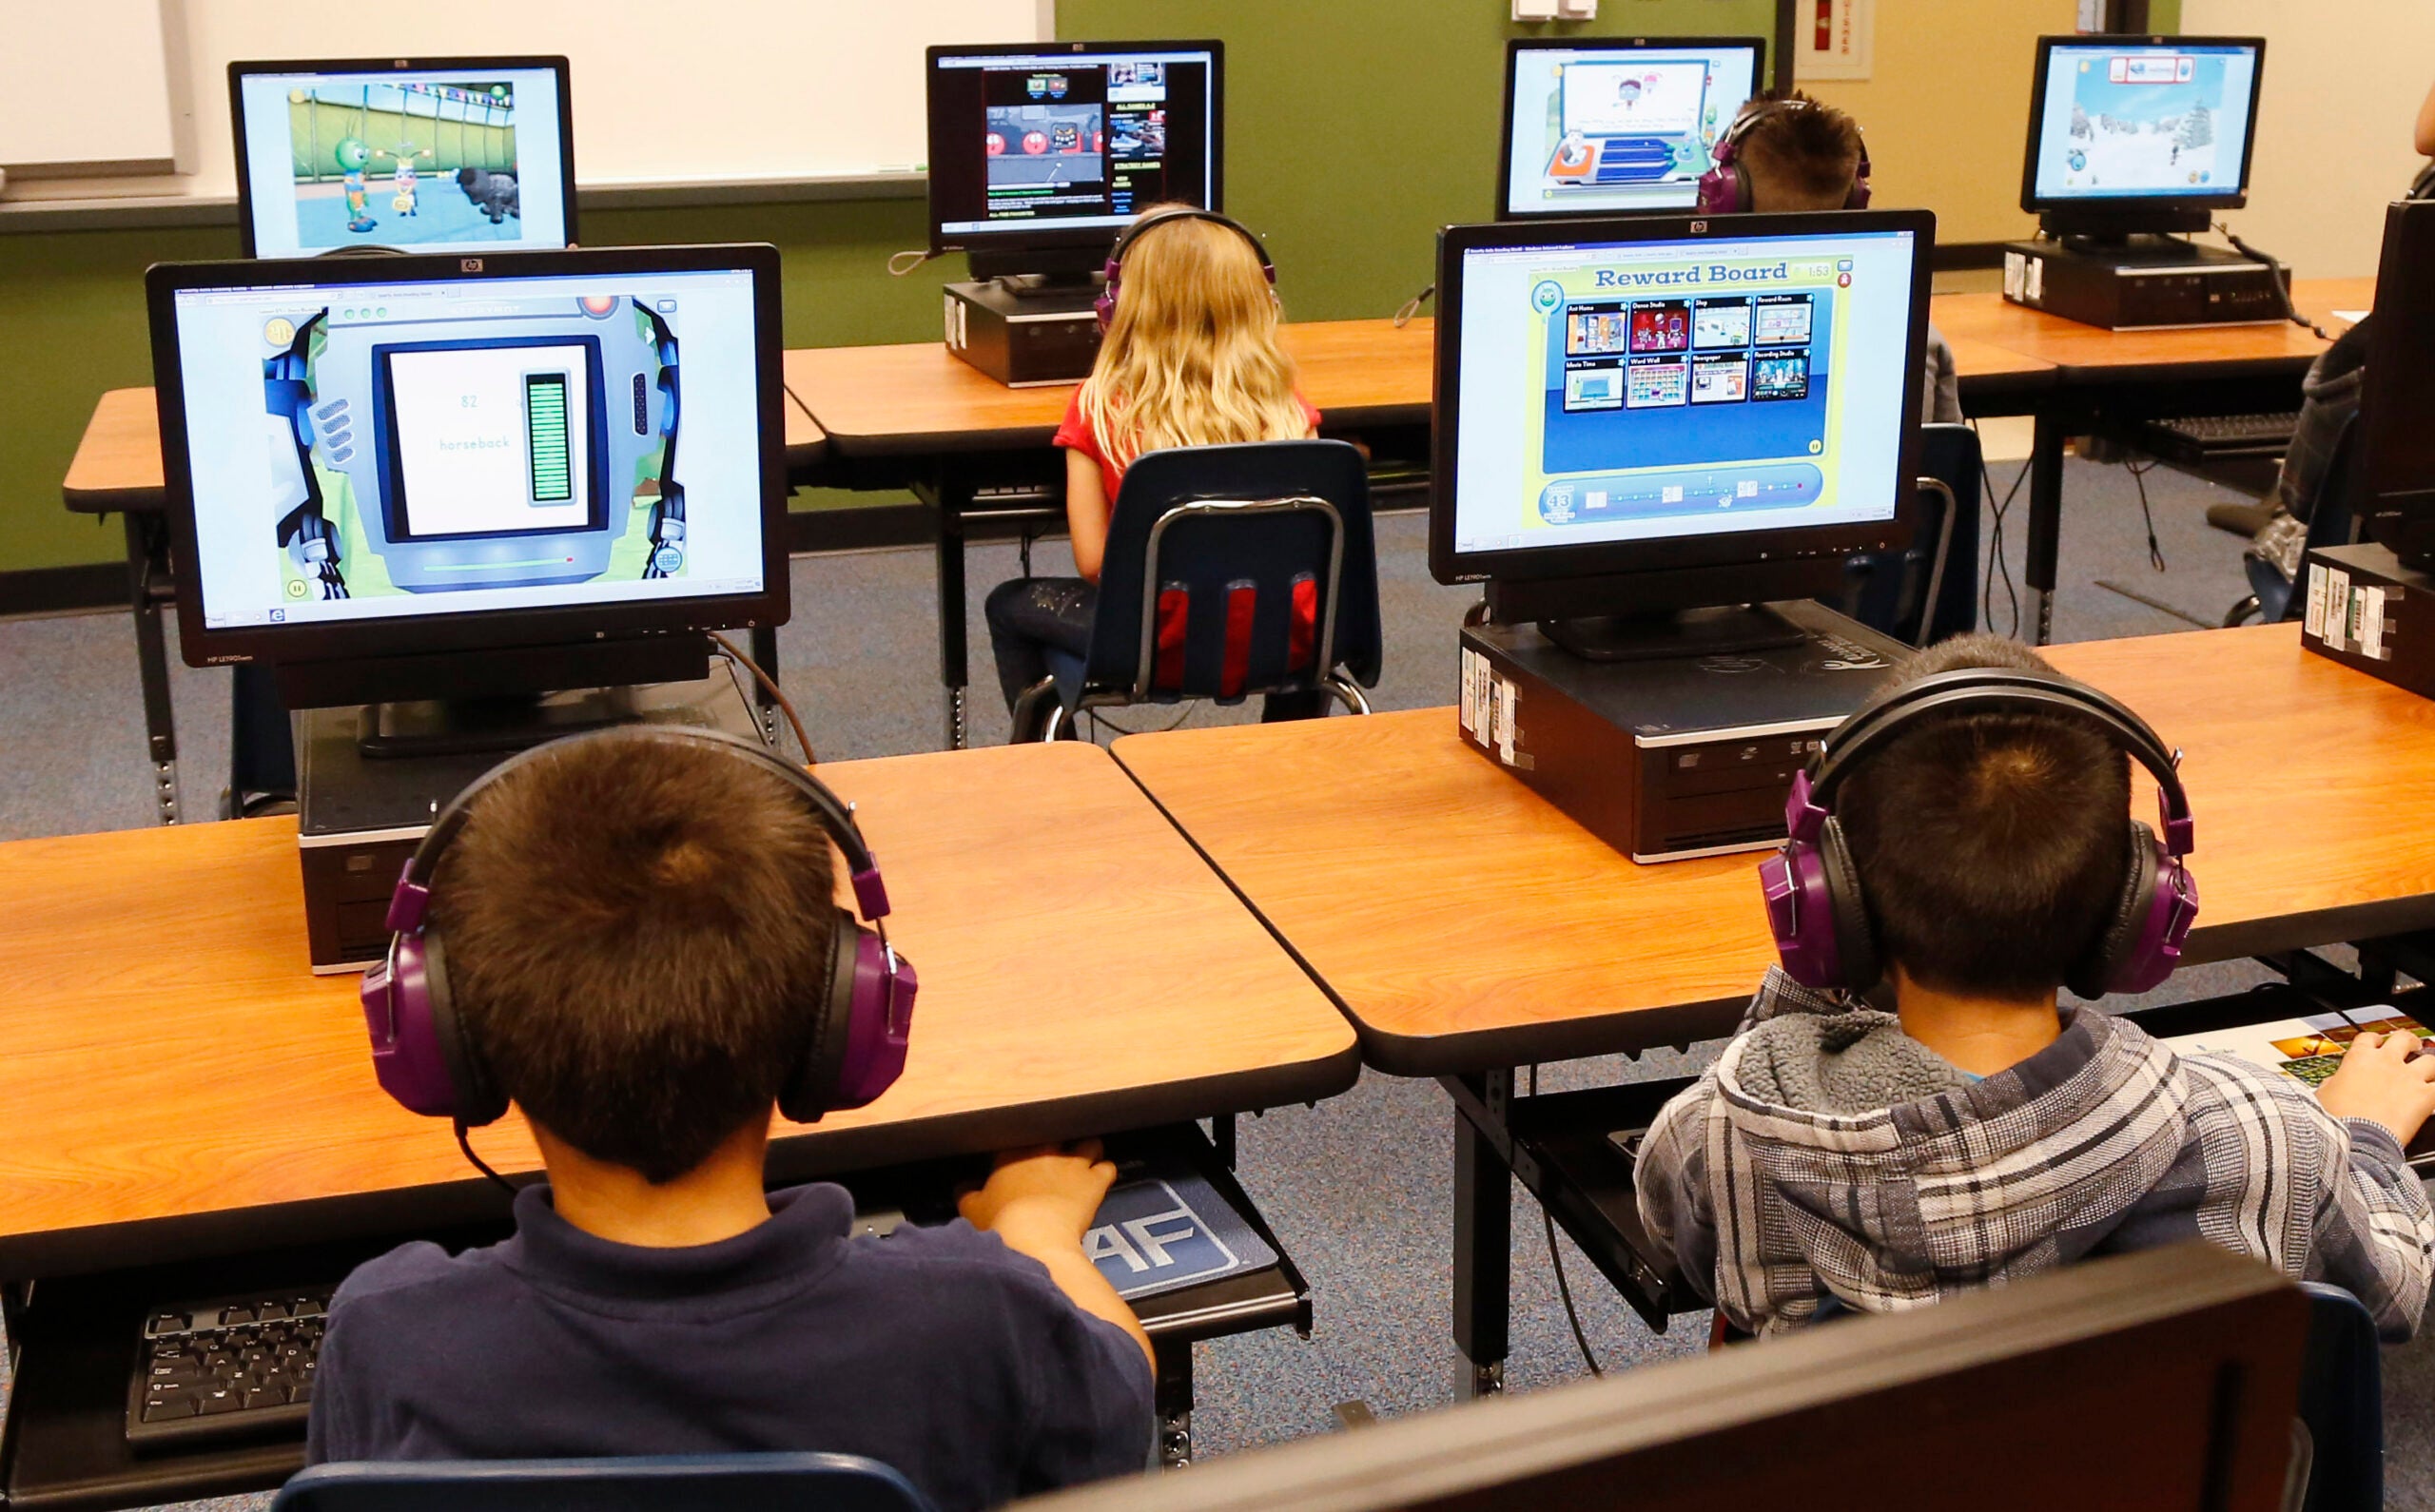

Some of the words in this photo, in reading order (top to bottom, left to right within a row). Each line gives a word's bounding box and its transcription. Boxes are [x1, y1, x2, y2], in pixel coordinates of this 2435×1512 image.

[1595, 265, 1702, 287] Reward
[1708, 262, 1788, 282] Board
[1809, 265, 1830, 277] 1:53
[460, 395, 478, 408] 82
[439, 436, 510, 451] horseback
[1549, 494, 1569, 507] 43
